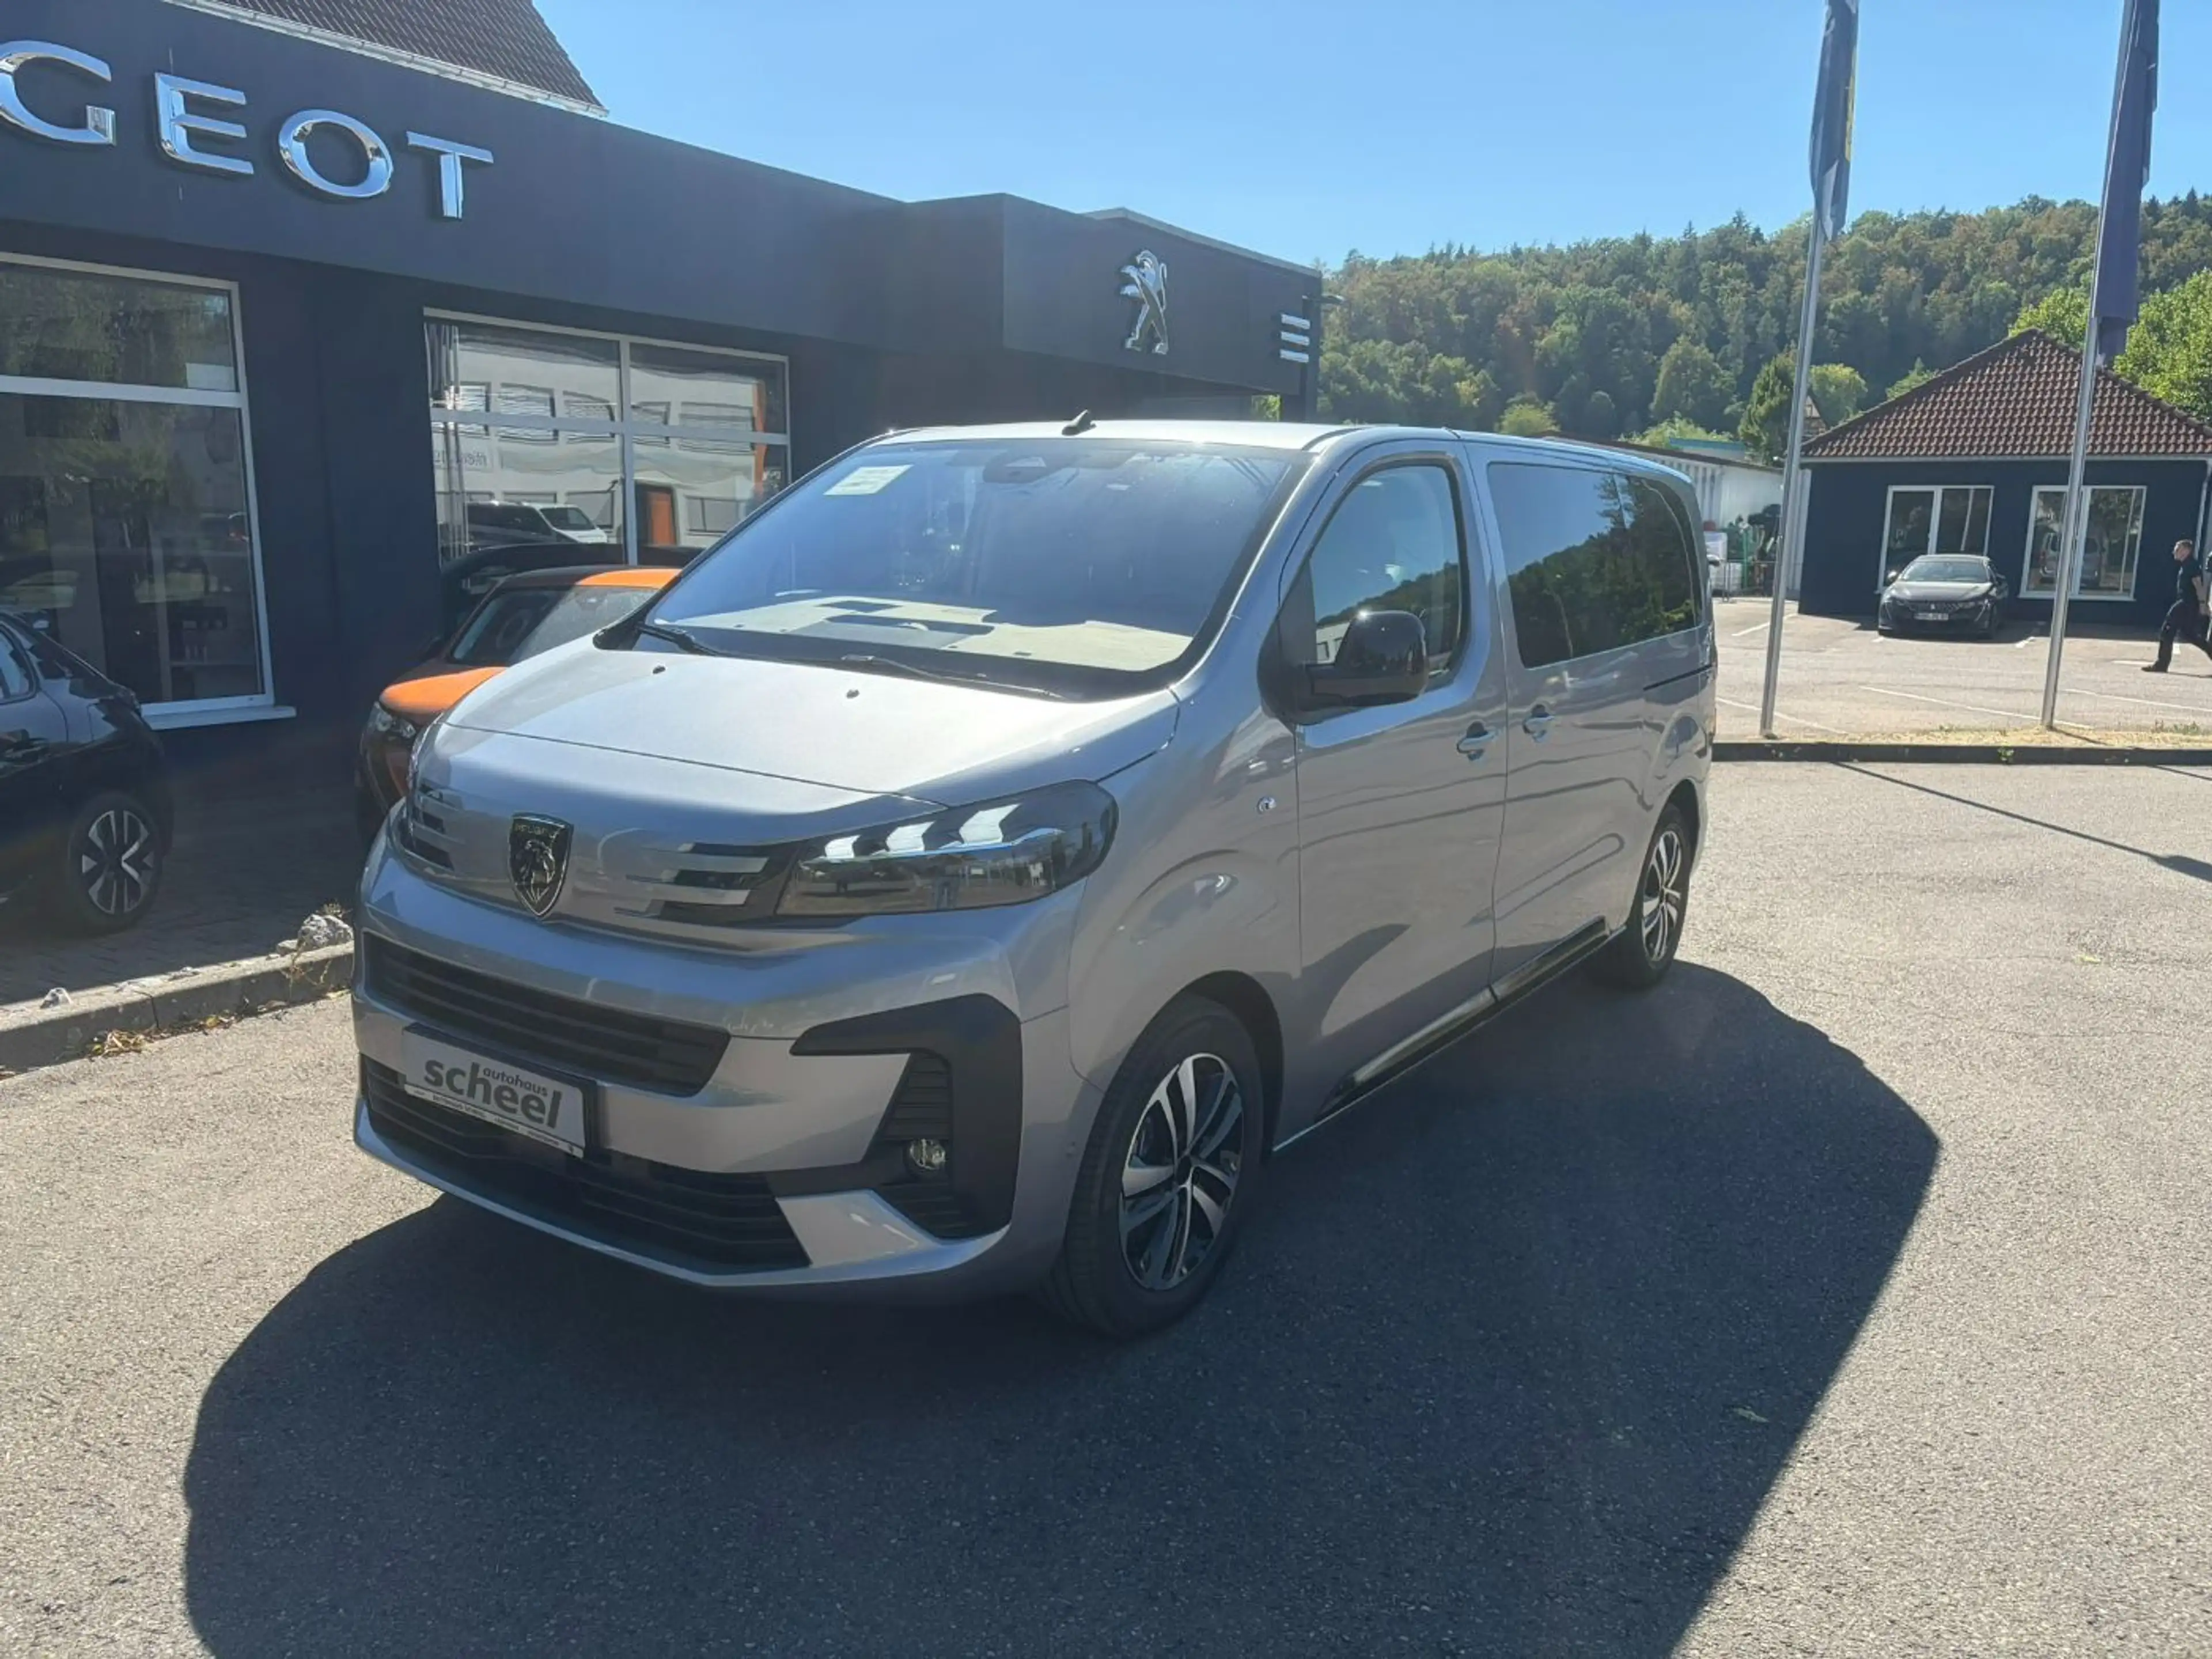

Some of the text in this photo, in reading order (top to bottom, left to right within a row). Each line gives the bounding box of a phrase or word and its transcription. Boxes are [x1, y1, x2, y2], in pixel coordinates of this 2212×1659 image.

[0, 40, 494, 219] GEOT
[424, 1060, 562, 1128] scheel
[483, 1067, 548, 1096] autohaus
